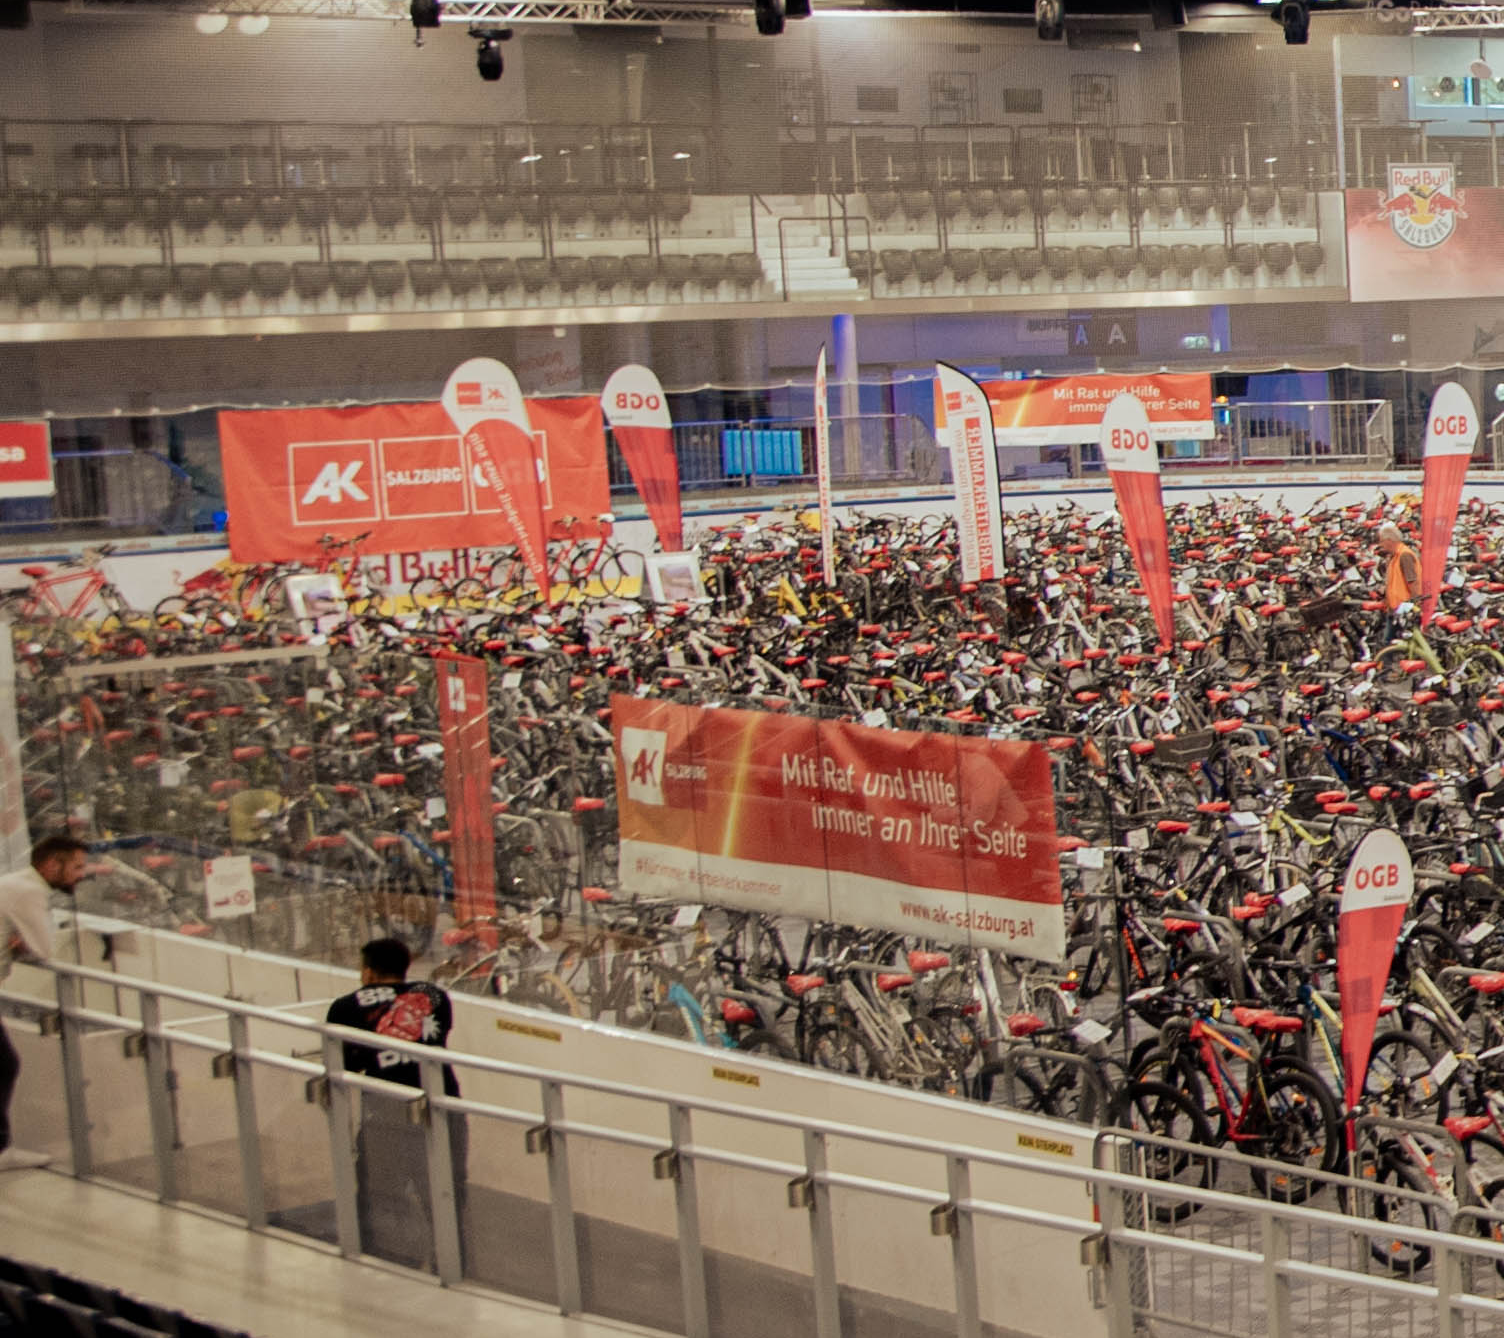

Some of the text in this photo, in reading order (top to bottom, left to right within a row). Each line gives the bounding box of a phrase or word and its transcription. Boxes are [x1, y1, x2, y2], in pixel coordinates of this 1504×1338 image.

[1107, 323, 1126, 344] A
[1054, 389, 1075, 400] Mit
[1078, 388, 1100, 399] Rat
[1069, 403, 1106, 413] imme
[1168, 398, 1201, 411] Seite
[303, 460, 371, 505] AK
[386, 467, 463, 488] SALZBURG
[631, 748, 660, 787] AK
[782, 752, 956, 806] Mit Rat und Hilfe
[811, 796, 872, 838] immer
[880, 814, 913, 843] an
[974, 821, 1028, 860] Seite
[900, 900, 1036, 941] www.ak-salzburg.at
